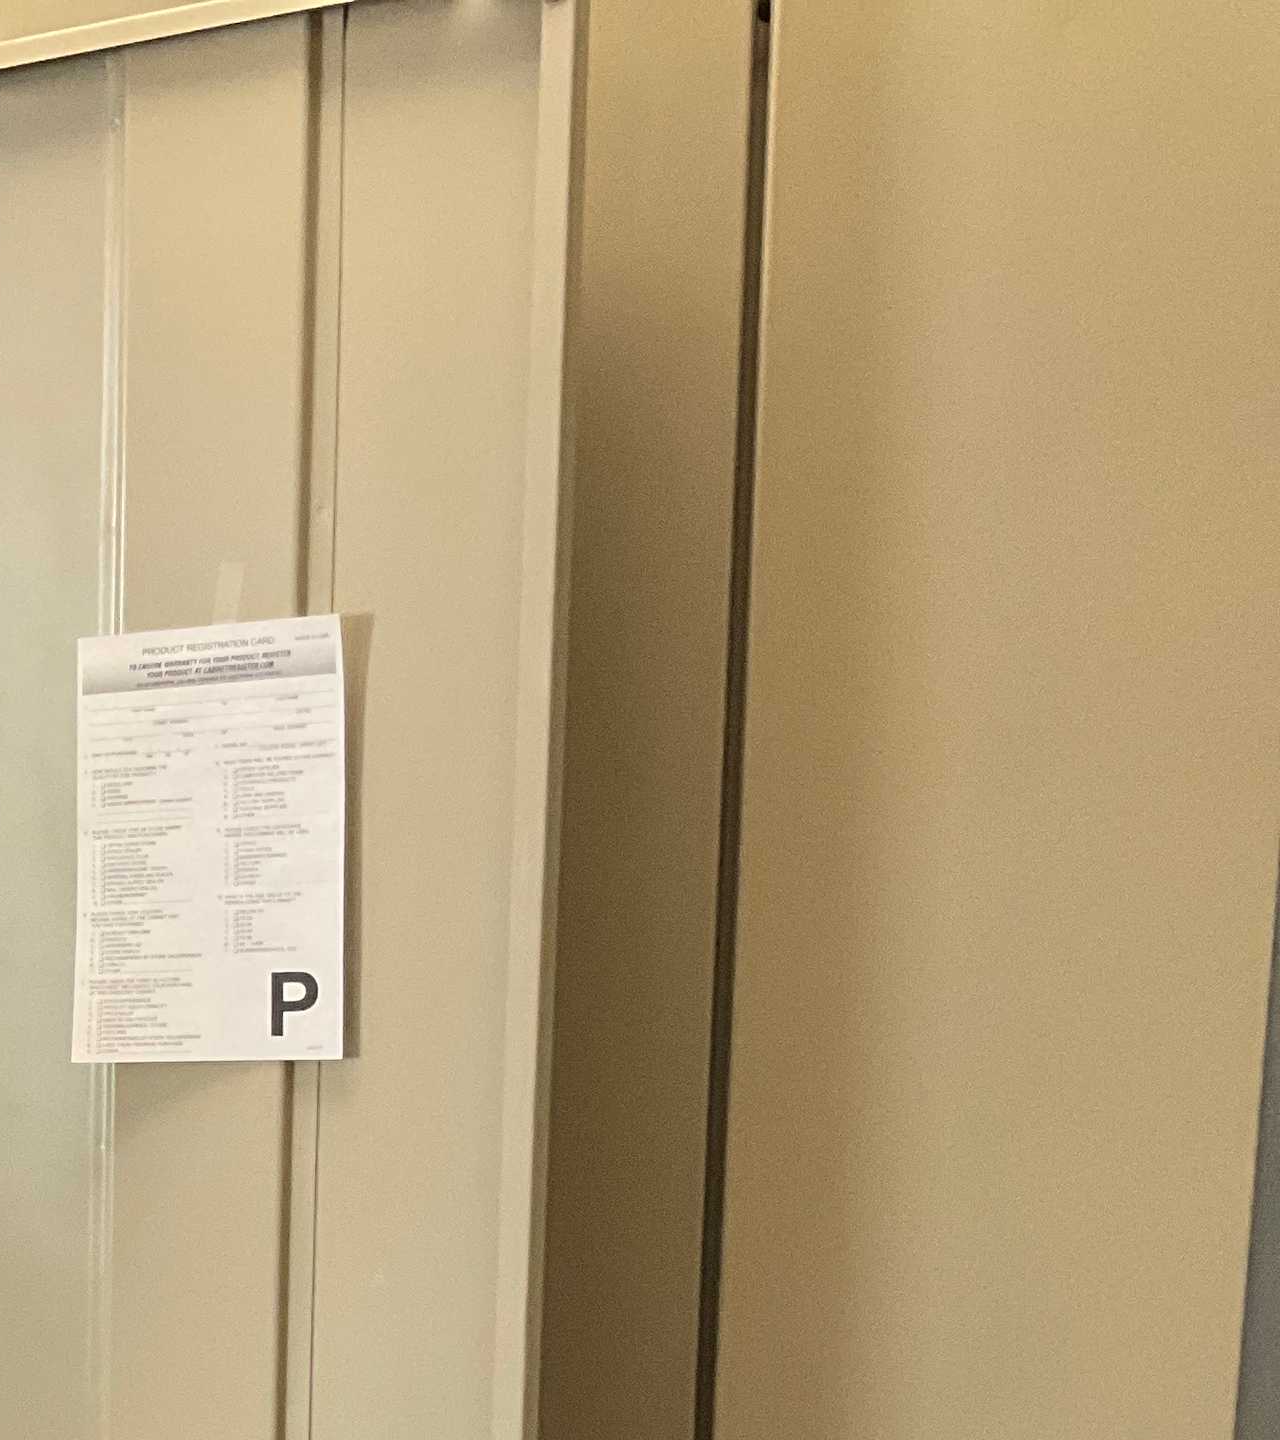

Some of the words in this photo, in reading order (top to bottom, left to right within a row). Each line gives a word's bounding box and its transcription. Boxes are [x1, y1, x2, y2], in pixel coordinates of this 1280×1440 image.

[142, 644, 185, 656] PRODUCT
[187, 638, 248, 652] REGISTRATION
[271, 971, 319, 1037] P
